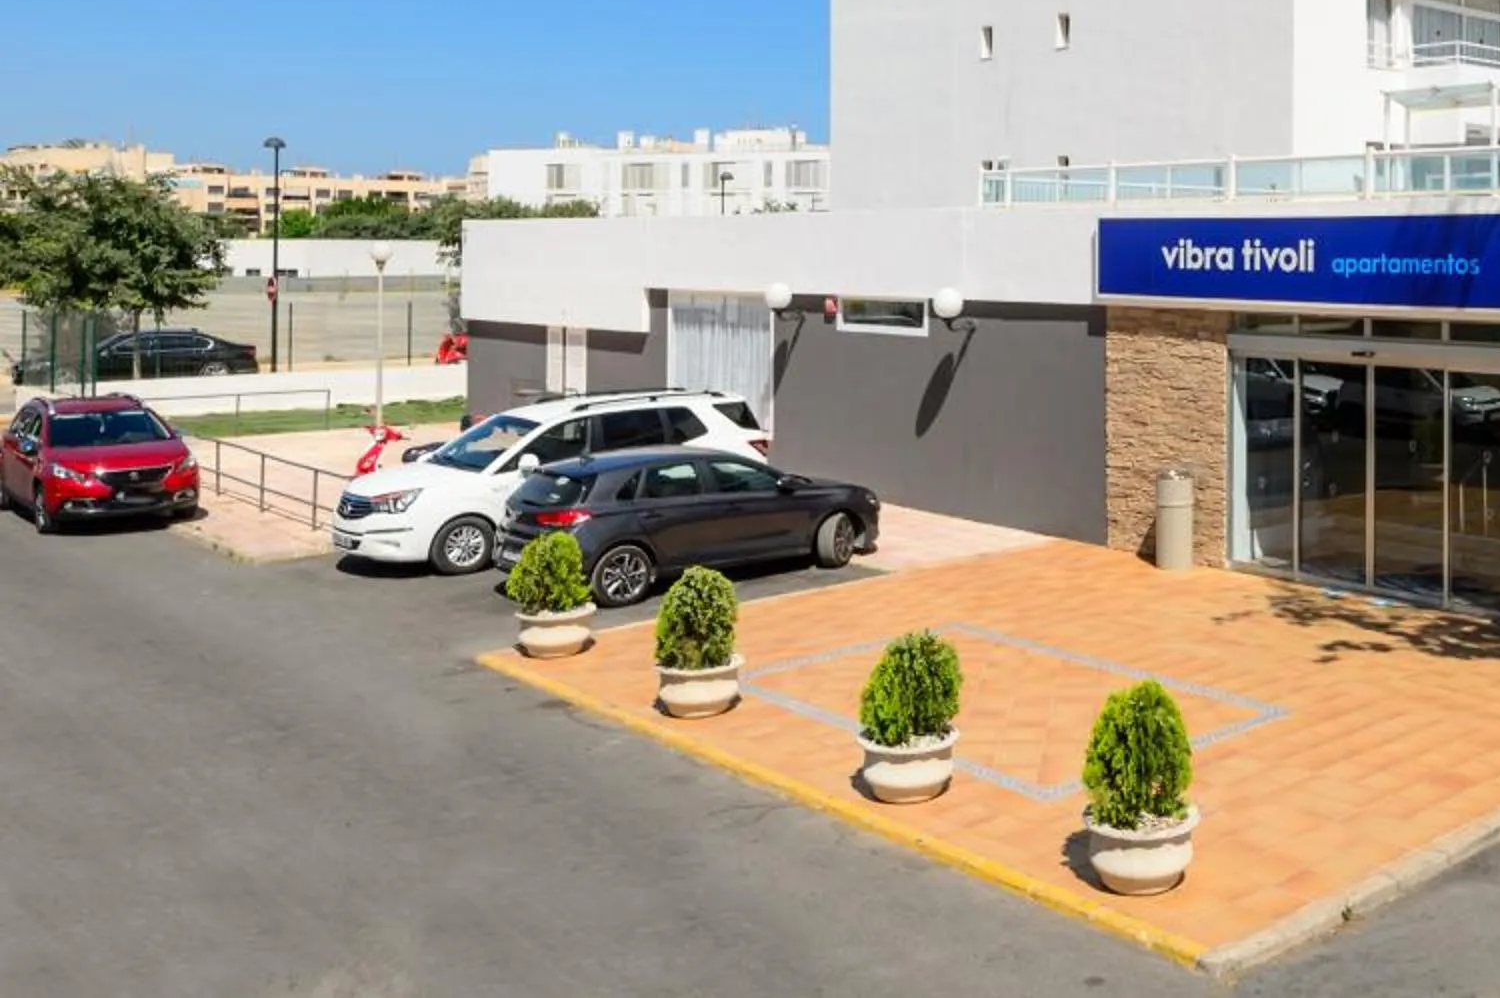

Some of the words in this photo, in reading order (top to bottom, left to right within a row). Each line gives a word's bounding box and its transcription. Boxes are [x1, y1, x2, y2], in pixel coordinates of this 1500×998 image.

[1161, 238, 1234, 271] vibra
[1242, 238, 1315, 273] tivoli
[1331, 253, 1480, 278] apartamentos
